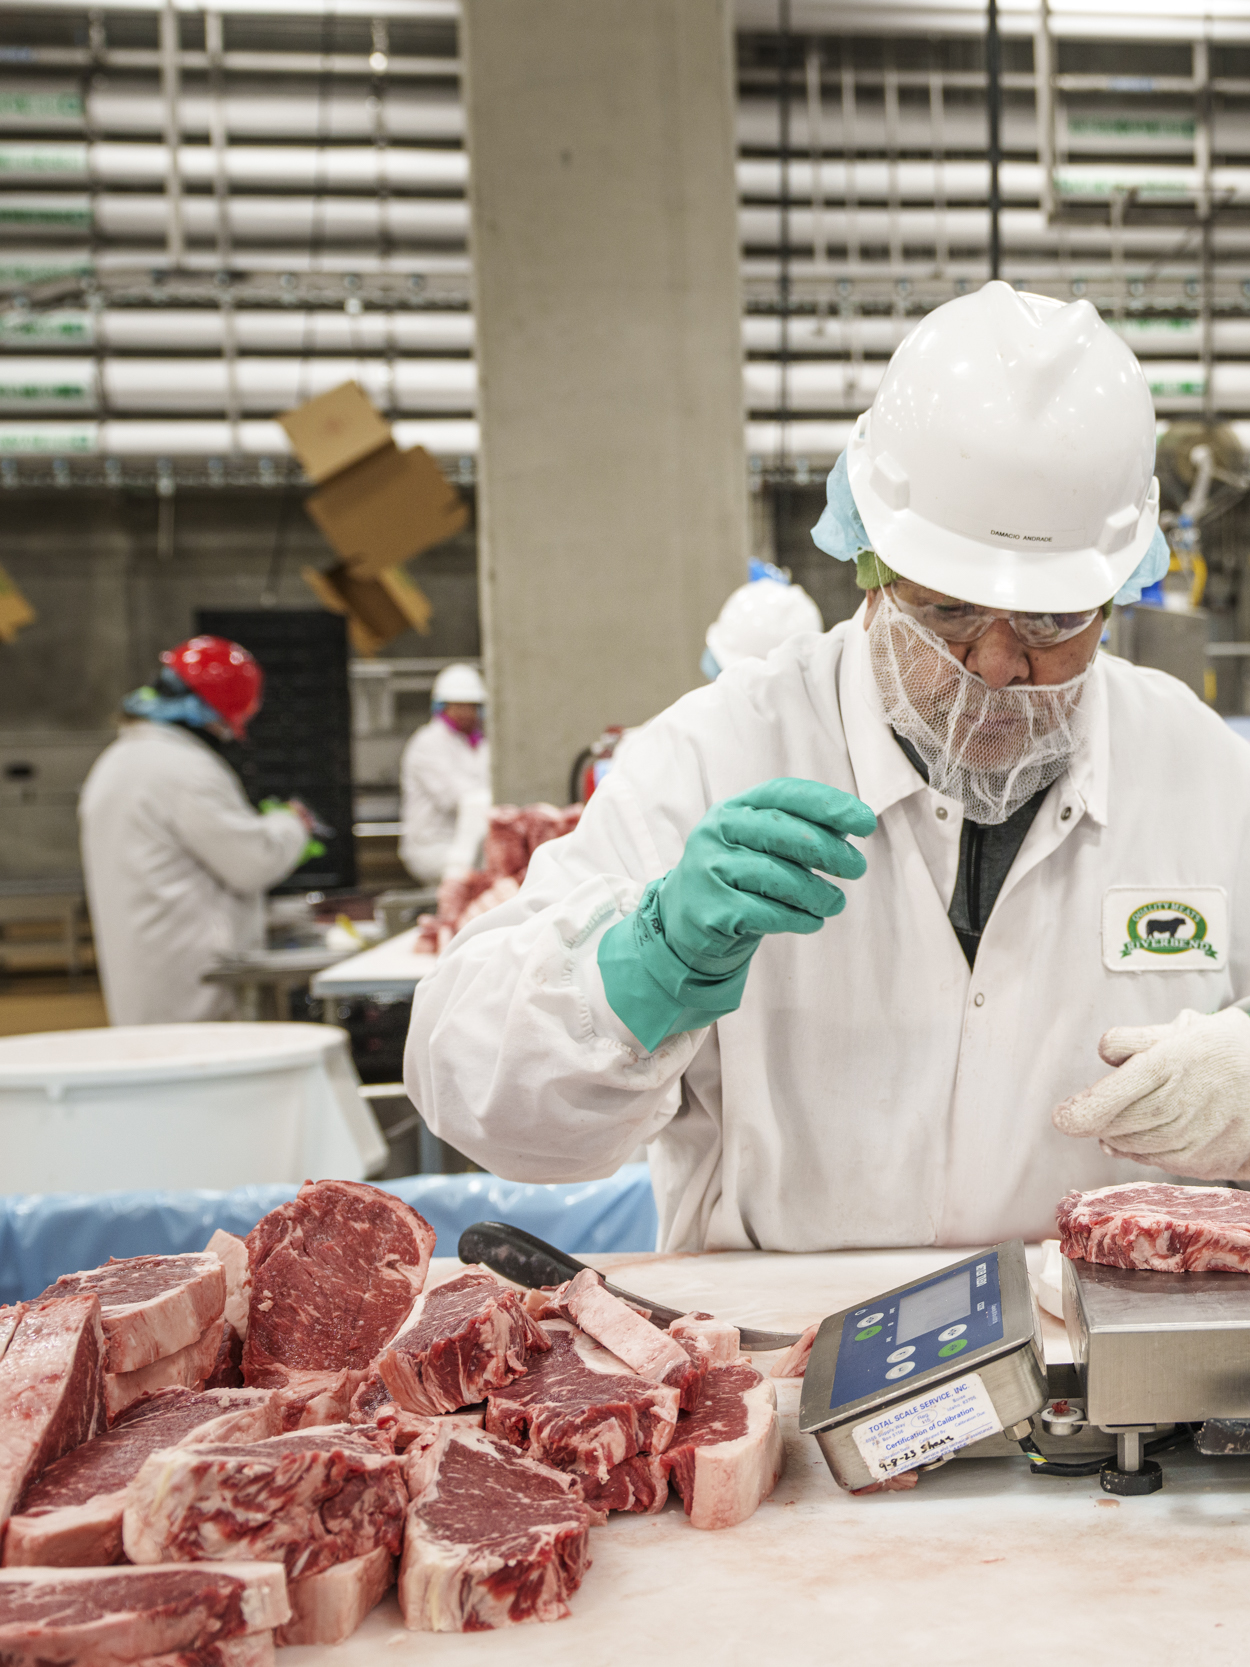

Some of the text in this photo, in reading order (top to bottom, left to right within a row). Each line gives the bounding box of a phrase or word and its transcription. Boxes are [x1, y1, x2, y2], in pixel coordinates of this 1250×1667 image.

[990, 529, 1020, 540] DAMACIO
[1131, 902, 1201, 922] QUALITY MEATS
[869, 1418, 894, 1433] TOTAL
[894, 1407, 919, 1421] SCALE
[885, 1428, 928, 1450] Certification
[936, 1406, 975, 1426] Calibration
